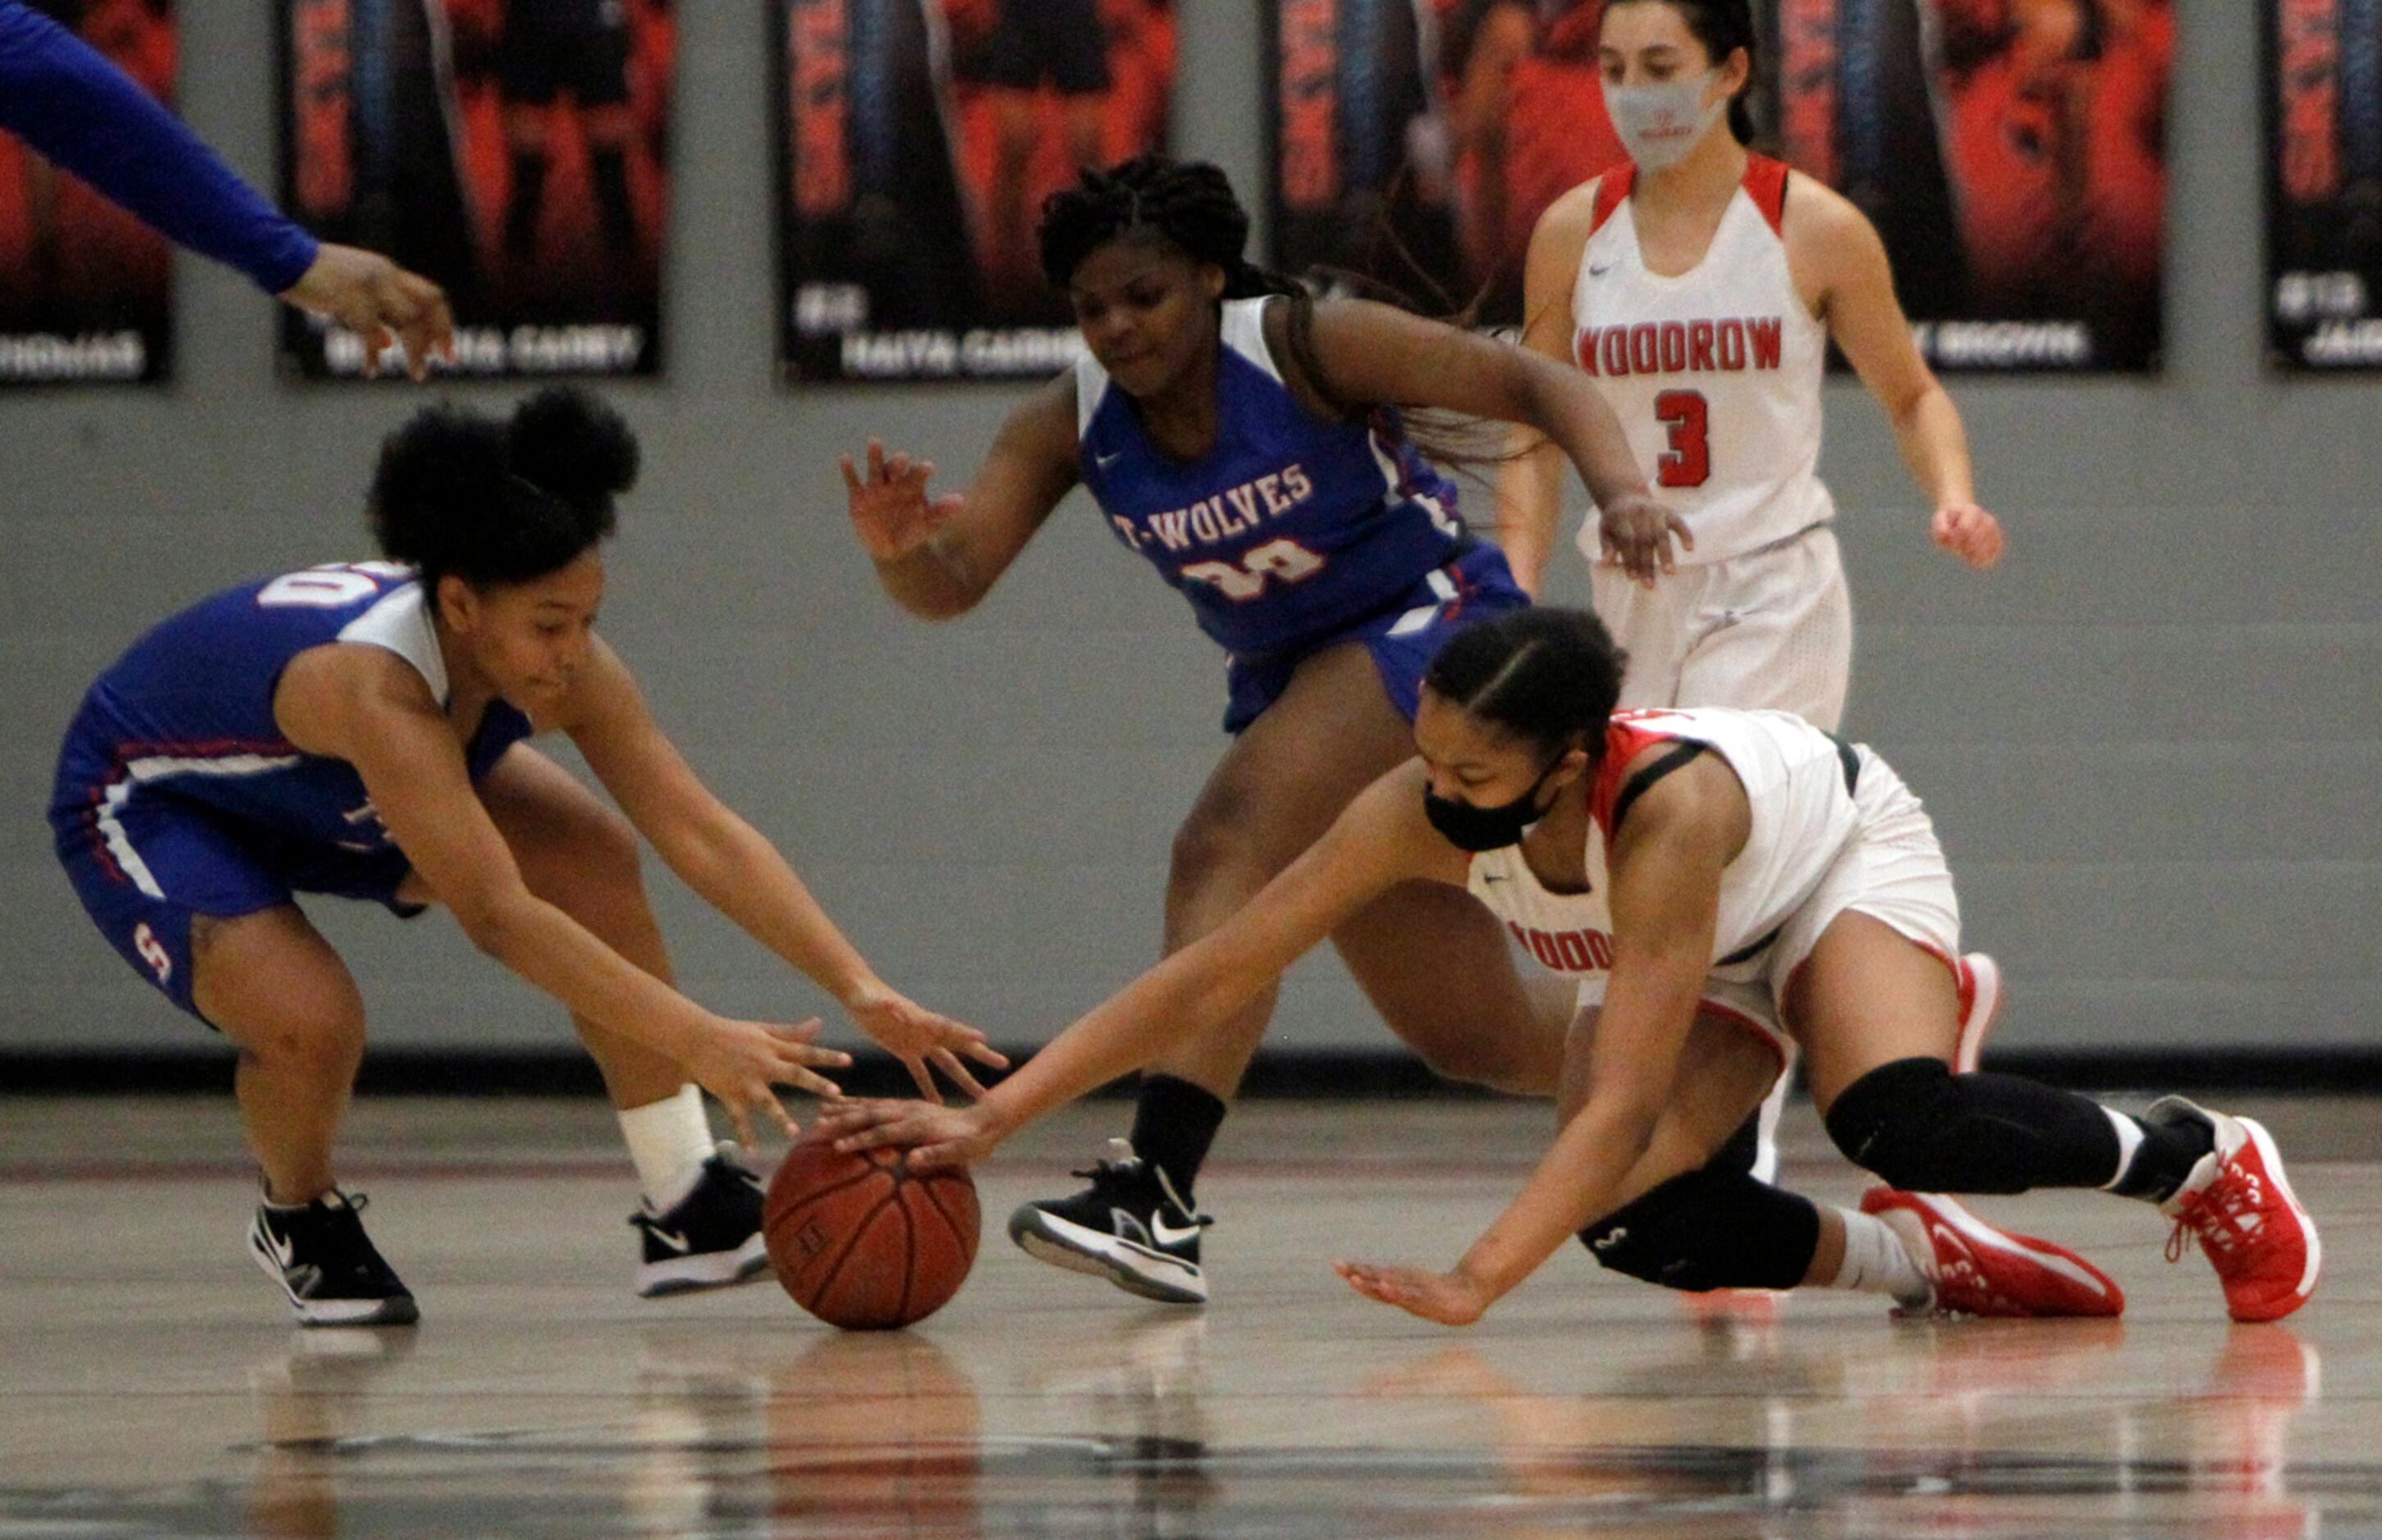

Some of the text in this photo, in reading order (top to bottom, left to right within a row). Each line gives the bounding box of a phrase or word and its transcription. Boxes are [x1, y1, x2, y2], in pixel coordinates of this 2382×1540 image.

[1578, 317, 1782, 377] WOODROW
[1655, 388, 1710, 487] 3
[1113, 463, 1312, 550] T-WOLVES
